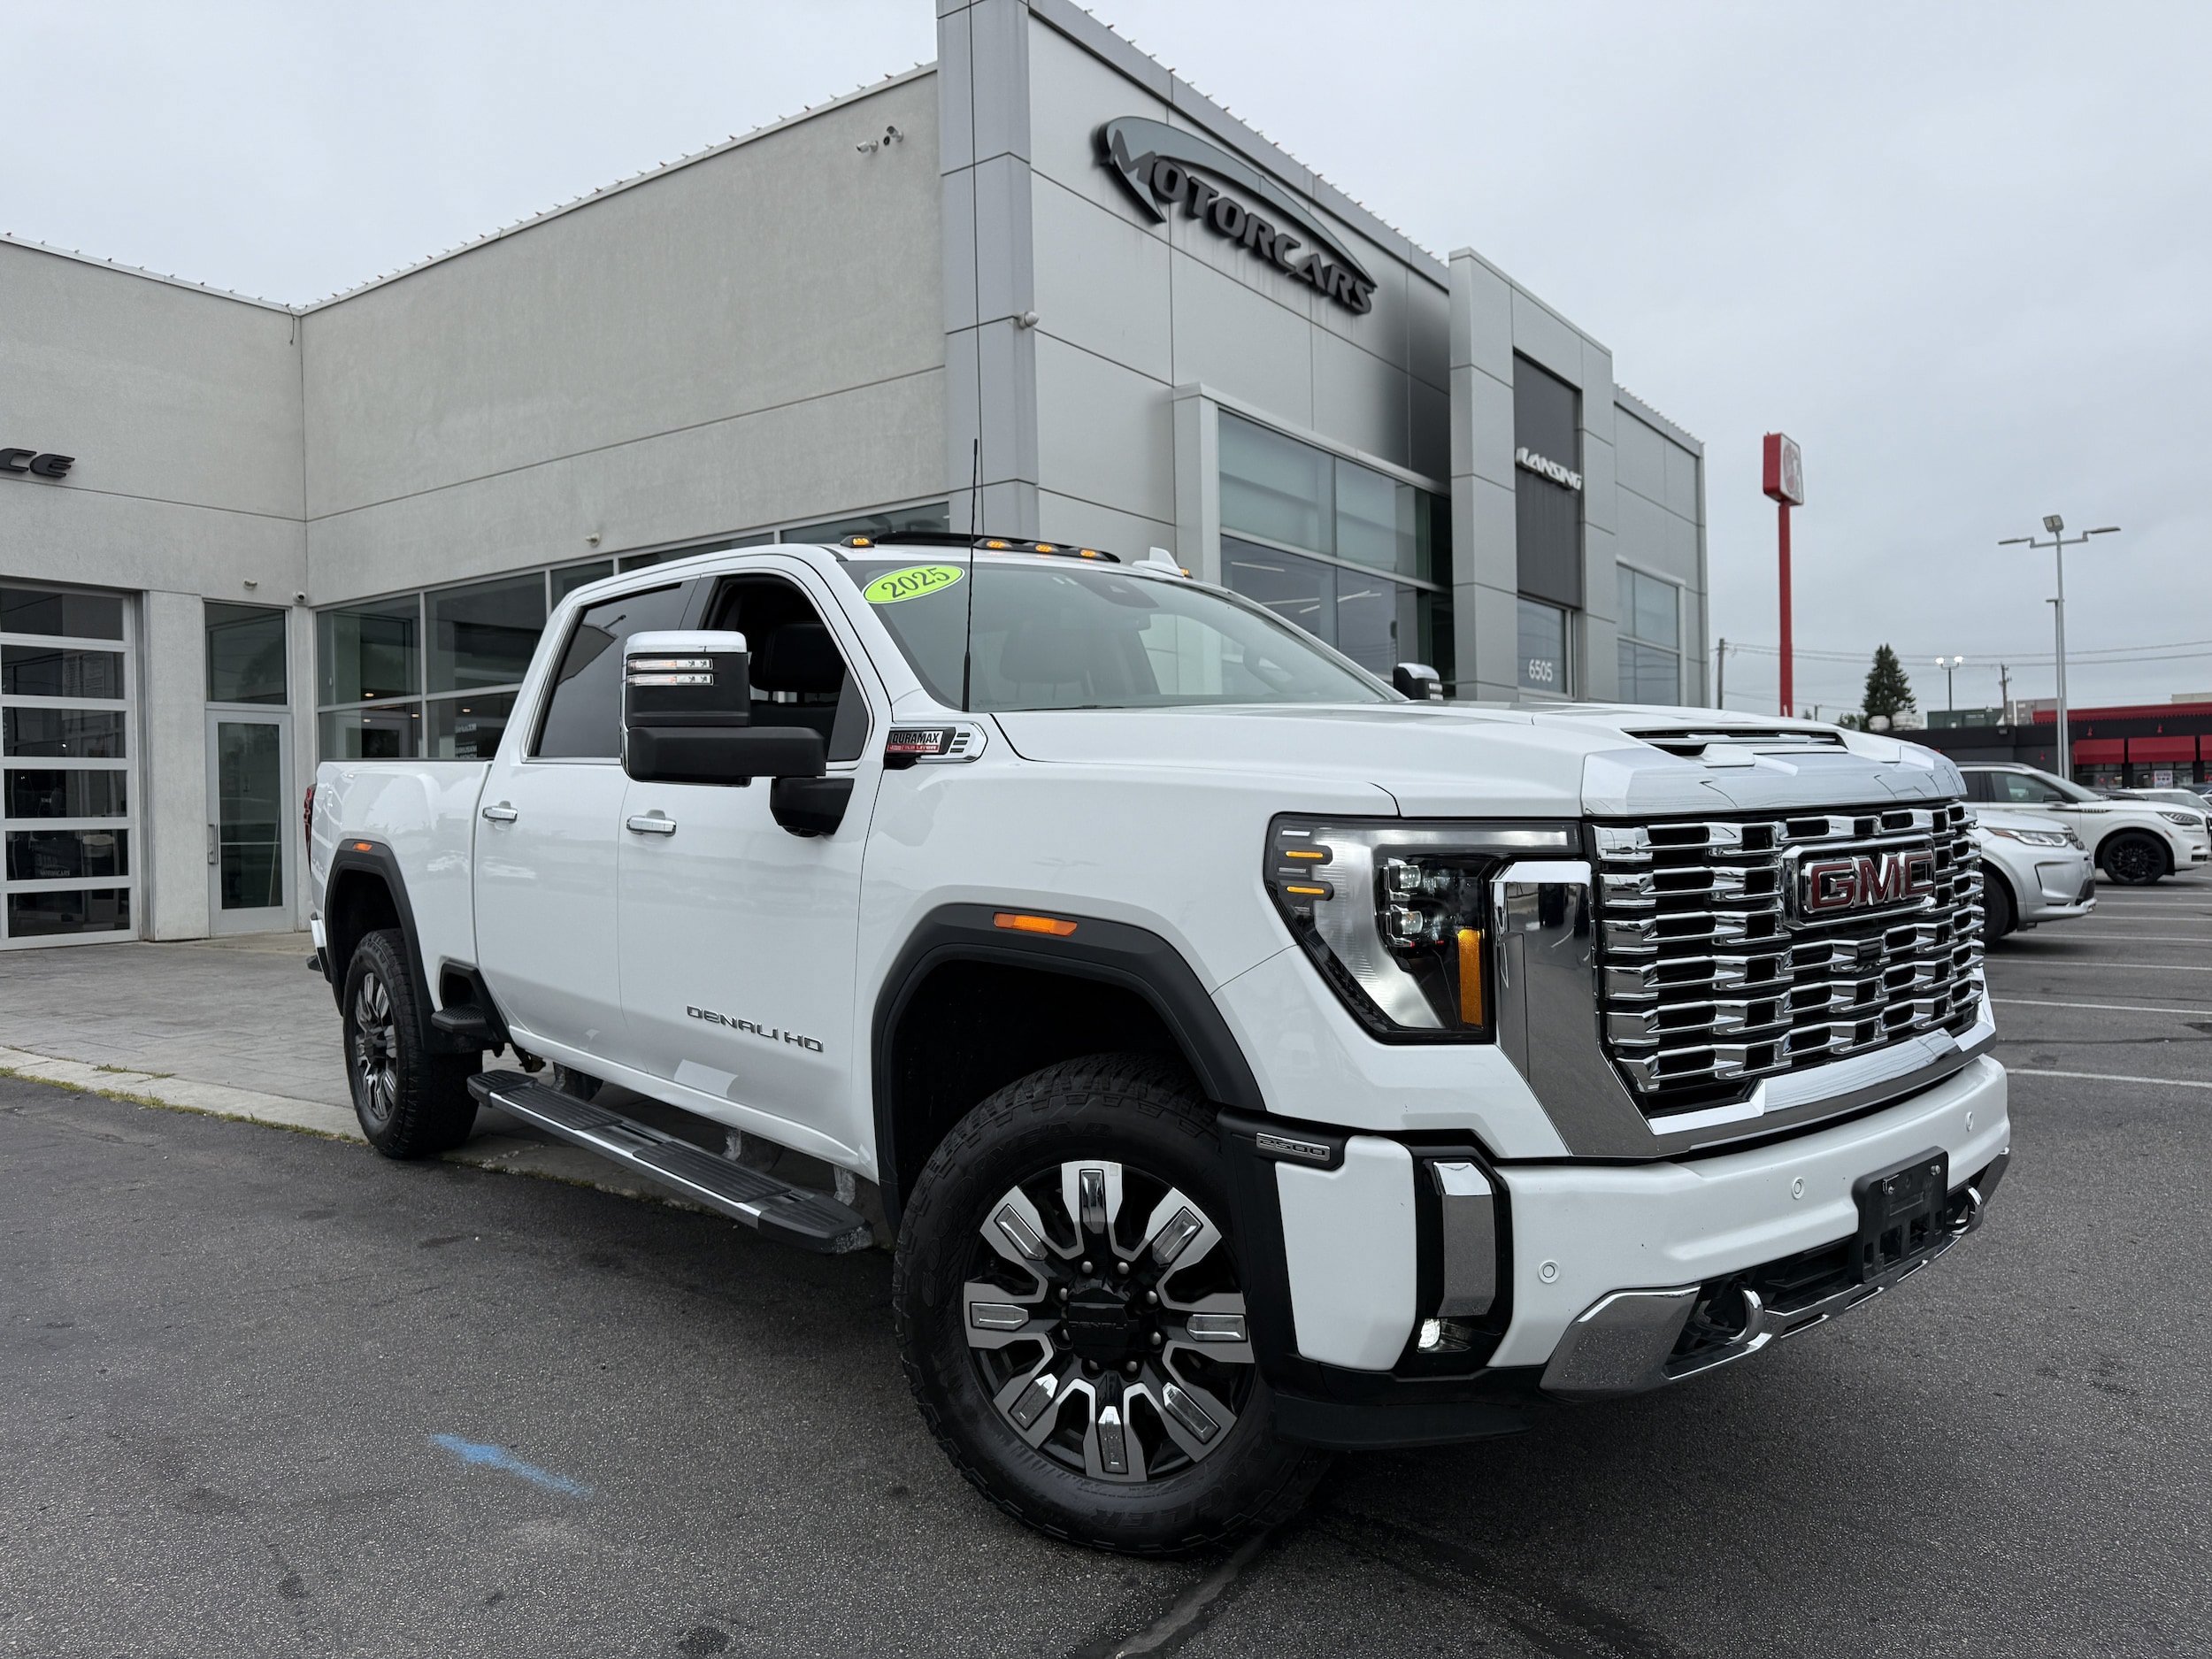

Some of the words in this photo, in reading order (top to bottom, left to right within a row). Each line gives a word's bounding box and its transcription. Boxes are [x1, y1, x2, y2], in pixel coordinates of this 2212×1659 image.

[1109, 128, 1375, 314] MOTORCARS
[1516, 447, 1582, 490] LANSING
[881, 567, 950, 598] 2025
[1529, 659, 1553, 682] 6505
[891, 732, 940, 744] DURAMAX
[1800, 850, 1934, 914] GMC
[687, 1005, 779, 1041] DENALI
[784, 1030, 824, 1053] HD
[1259, 1137, 1326, 1157] 2500
